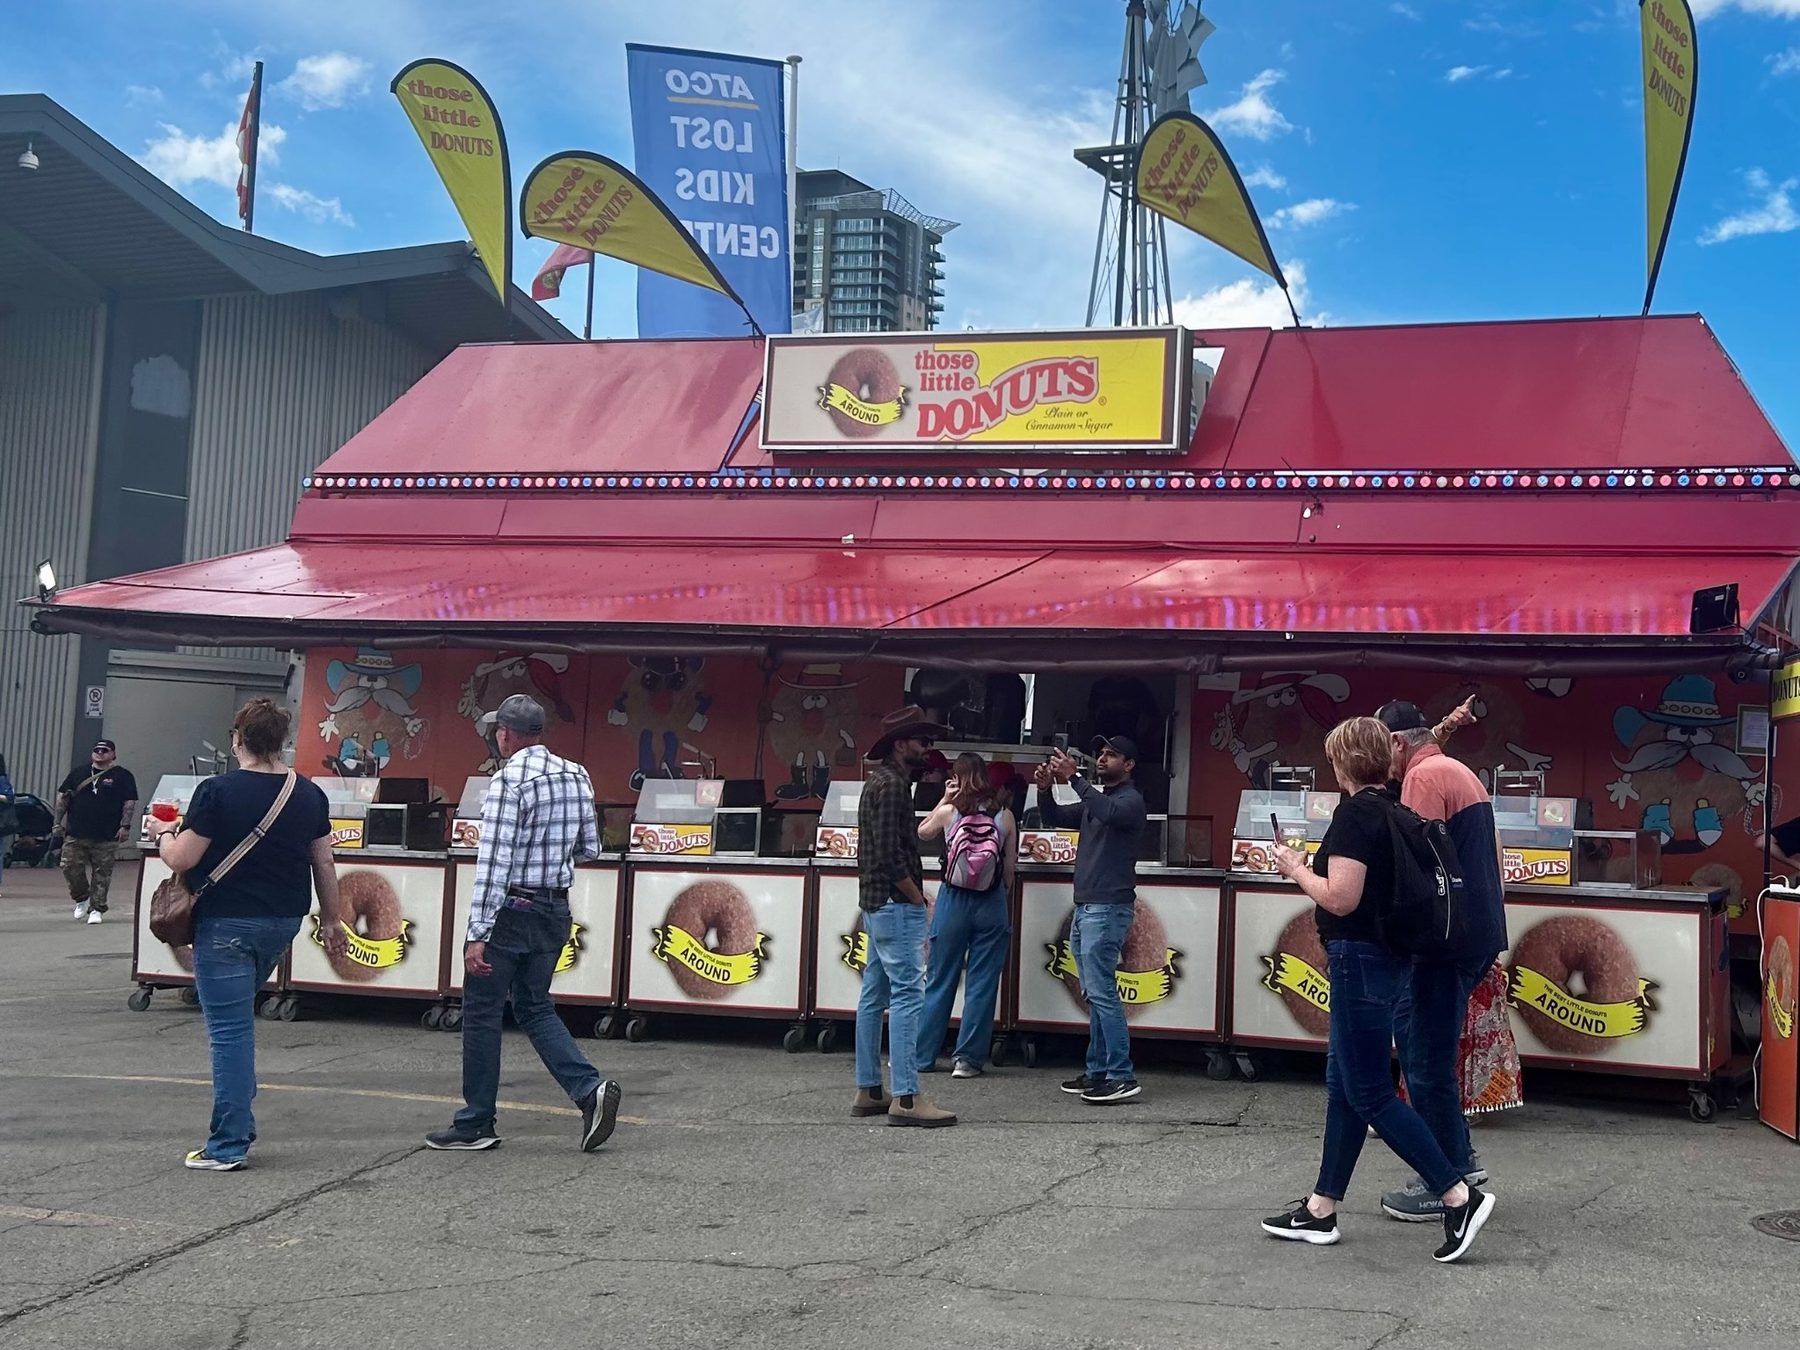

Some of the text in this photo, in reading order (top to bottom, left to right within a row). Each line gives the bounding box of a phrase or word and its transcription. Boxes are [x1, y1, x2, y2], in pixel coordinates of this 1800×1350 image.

[1652, 1, 1688, 48] those
[1652, 32, 1685, 79] little
[407, 80, 473, 102] those
[1648, 67, 1687, 117] DONUTS
[423, 104, 480, 127] little
[430, 131, 494, 157] DONUTS
[1144, 128, 1186, 192] those
[1161, 144, 1200, 202] little
[534, 166, 585, 224] those
[1176, 152, 1218, 221] DONUTS
[560, 178, 606, 232] little
[582, 185, 633, 247] DONUTS
[915, 350, 974, 370] those
[920, 373, 975, 391] little
[839, 399, 880, 423] AROUND
[916, 360, 1096, 437] DONUTS
[1043, 407, 1074, 419] Plain
[330, 829, 361, 843] NUTS
[660, 833, 709, 852] DONUTS
[1503, 860, 1567, 880] DONUTS
[347, 943, 379, 965] OUND
[680, 947, 731, 982] AROUND
[1296, 978, 1329, 1005] ARO
[1305, 969, 1315, 980] THE
[1313, 977, 1327, 988] BEST
[1534, 992, 1606, 1034] AROUND
[1543, 983, 1608, 1018] THE BEST LITTLE DONUTS
[1419, 1200, 1443, 1209] HOKA
